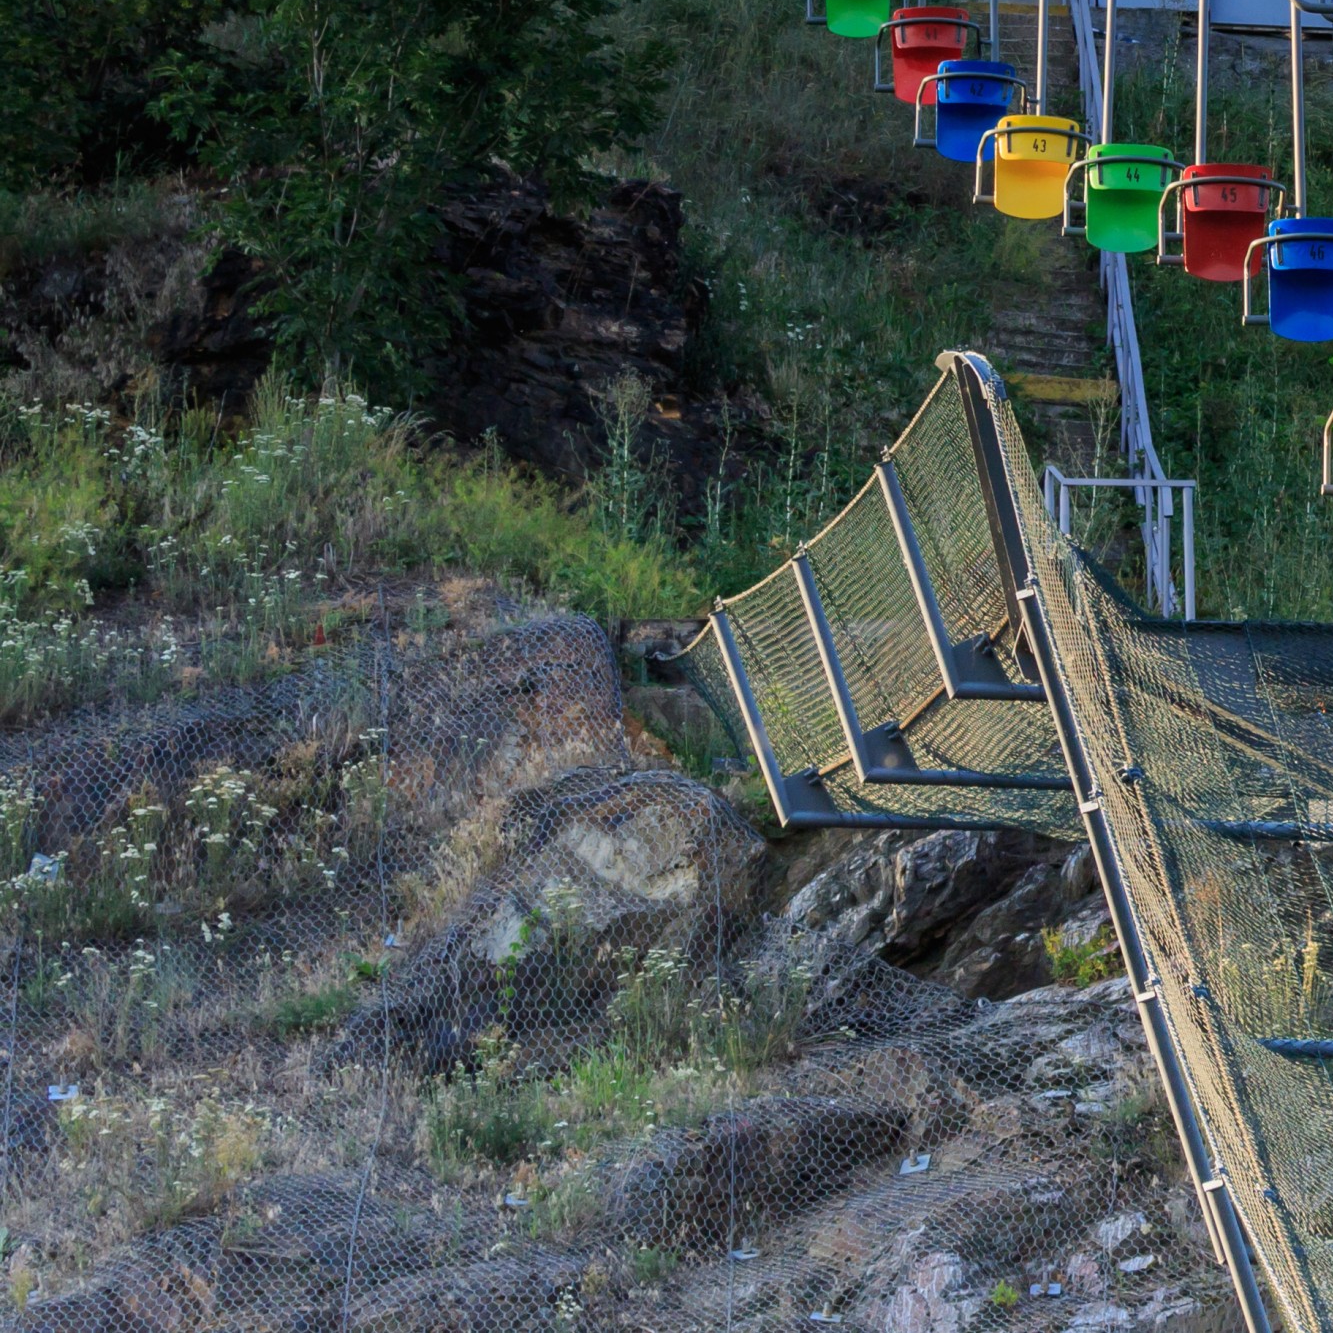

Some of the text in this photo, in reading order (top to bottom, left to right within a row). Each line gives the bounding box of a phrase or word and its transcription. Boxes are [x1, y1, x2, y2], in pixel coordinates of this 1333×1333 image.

[925, 26, 938, 40] 41
[970, 82, 984, 97] 42
[1033, 138, 1047, 153] 43
[1126, 167, 1140, 182] 44
[1221, 186, 1237, 203] 45
[1309, 245, 1325, 261] 46
